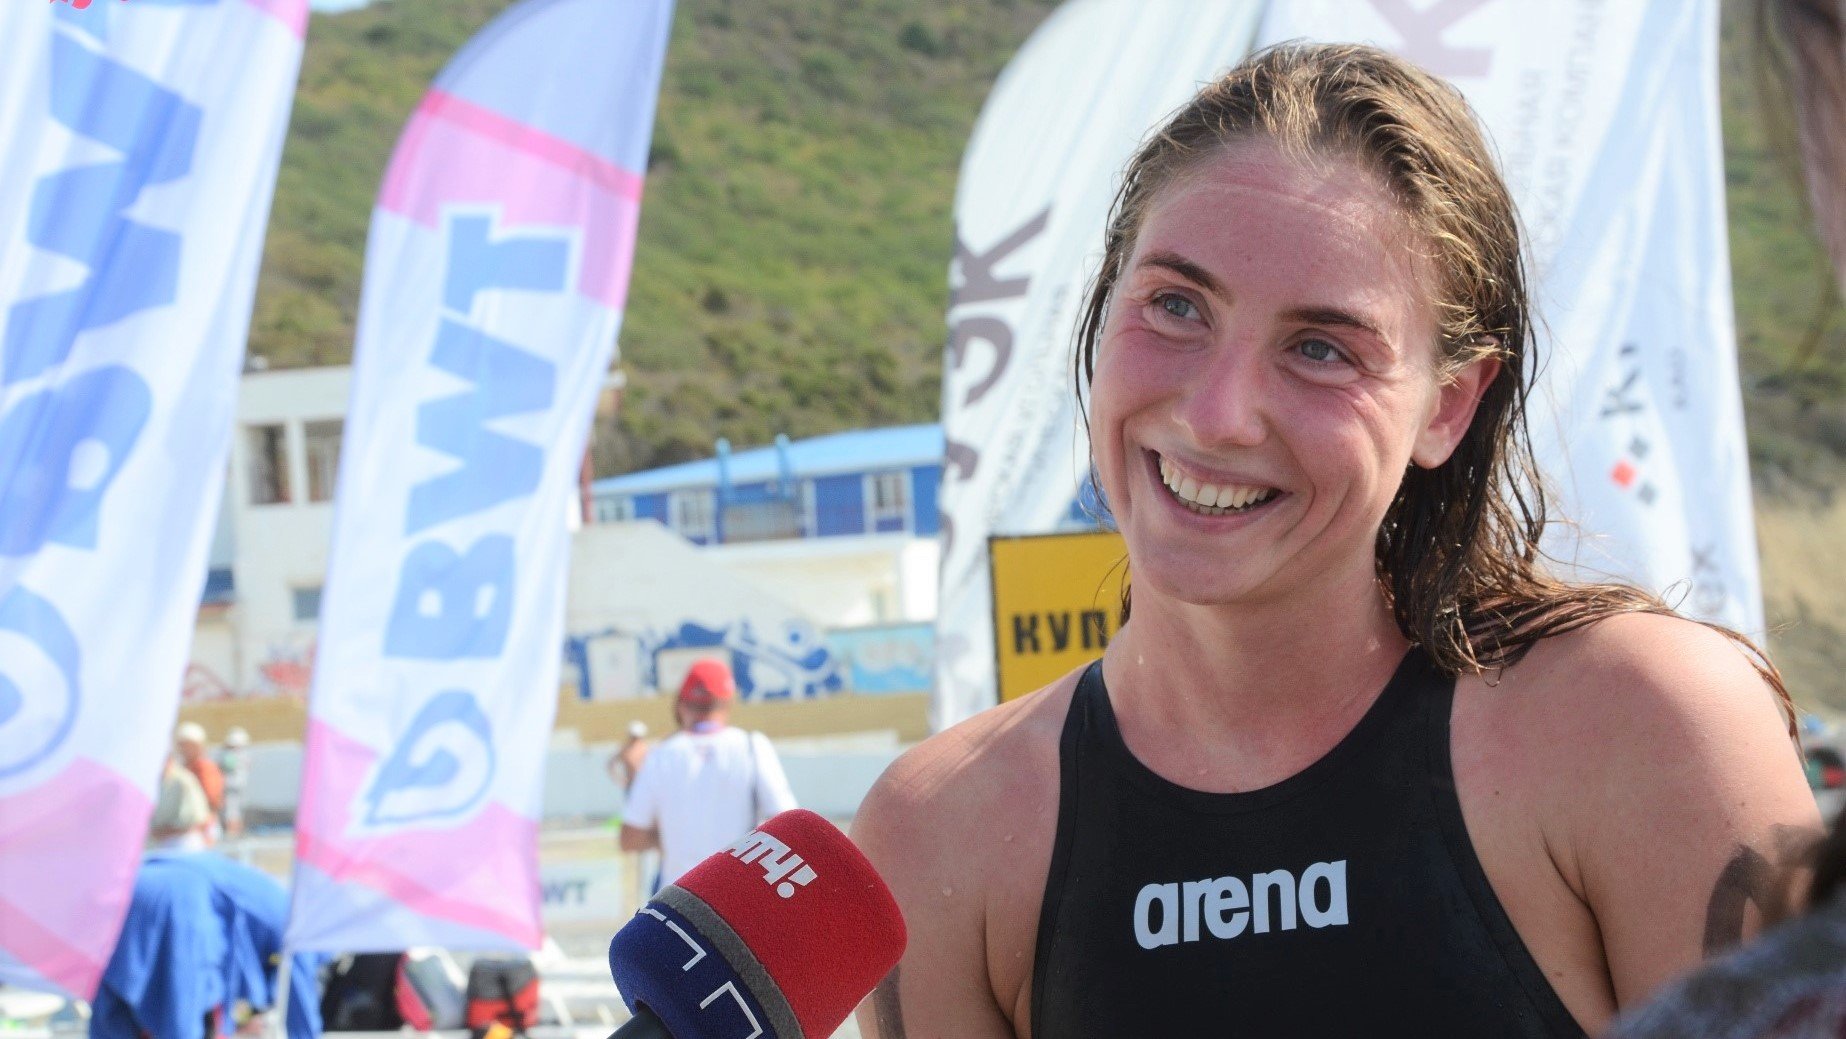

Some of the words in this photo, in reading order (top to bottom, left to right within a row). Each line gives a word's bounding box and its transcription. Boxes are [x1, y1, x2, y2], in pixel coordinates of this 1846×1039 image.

[383, 213, 571, 658] BWT
[1014, 612, 1110, 655] КУП
[1134, 859, 1349, 950] arena
